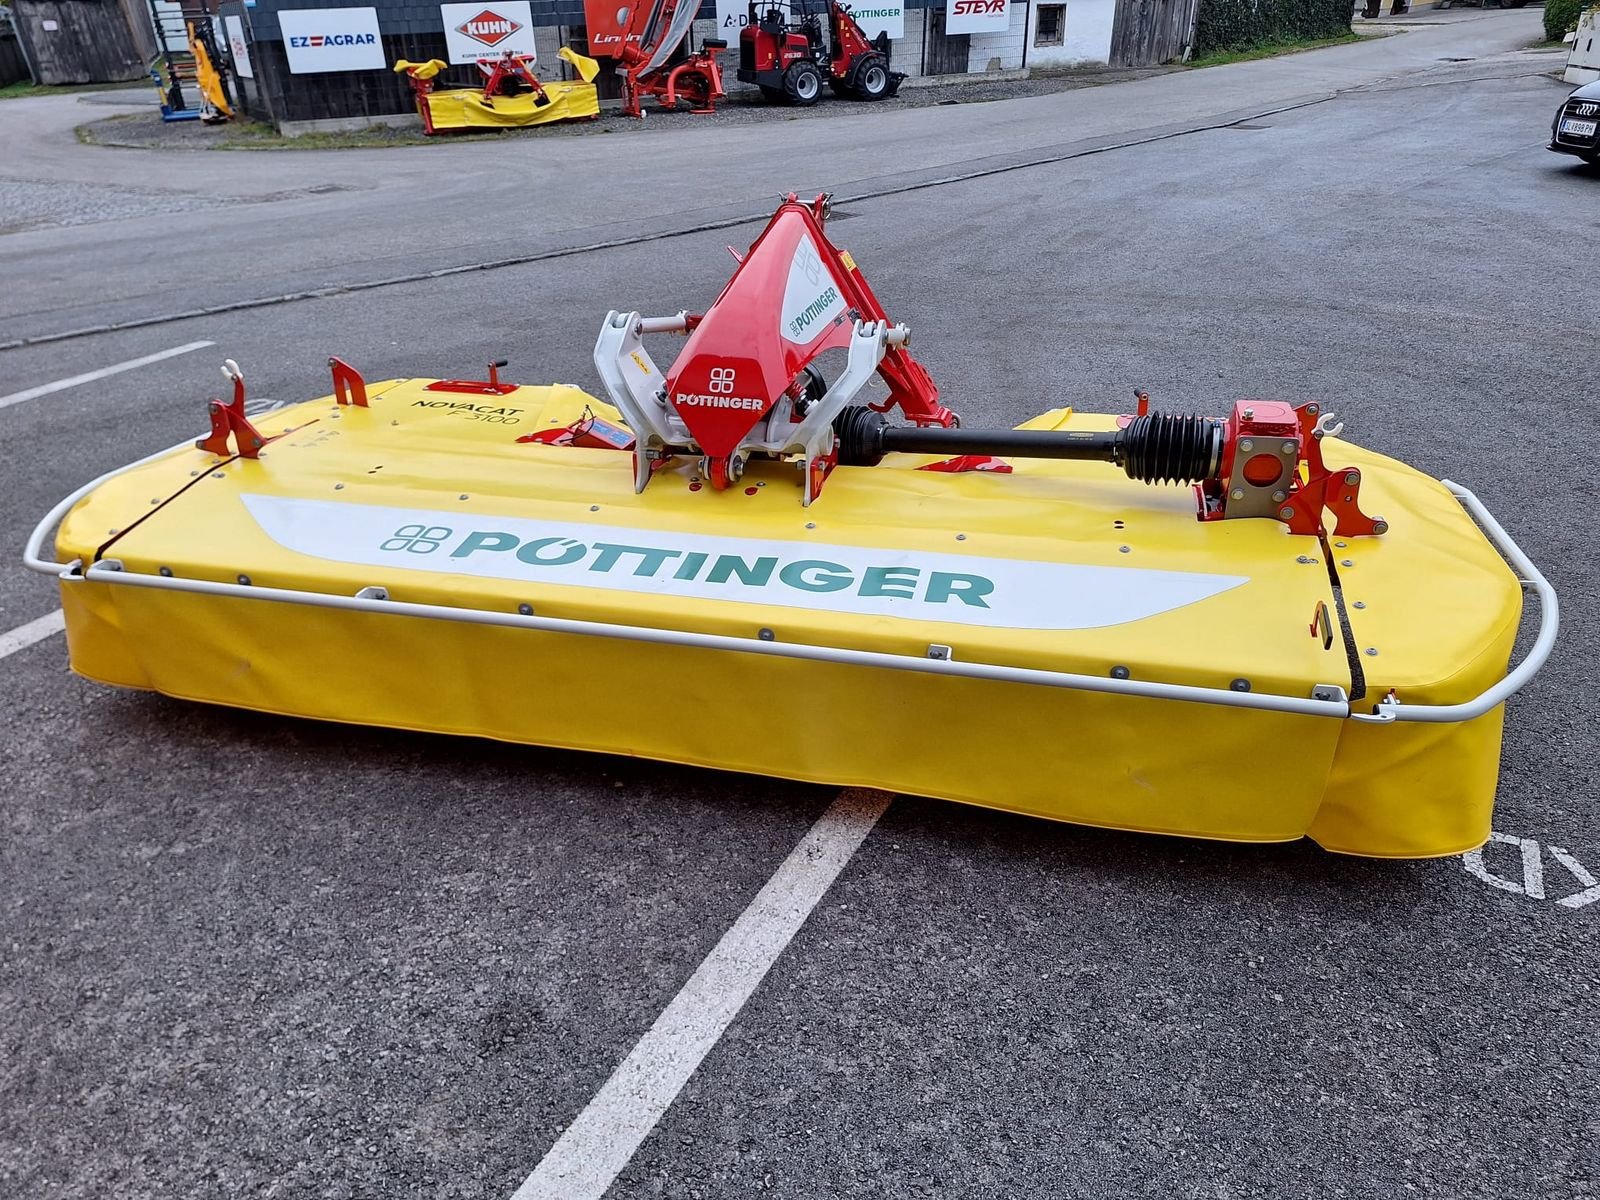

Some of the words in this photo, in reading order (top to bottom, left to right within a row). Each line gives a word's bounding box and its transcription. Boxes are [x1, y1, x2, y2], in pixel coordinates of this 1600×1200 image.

[953, 0, 1006, 15] STEYR
[466, 21, 512, 35] KUHN
[290, 36, 310, 48] EZ
[324, 33, 376, 47] AGRAR
[411, 400, 525, 416] NOVACAT
[676, 393, 764, 410] PÖTTINGER
[464, 413, 521, 425] 3100
[450, 531, 995, 610] PÖTTINGER
